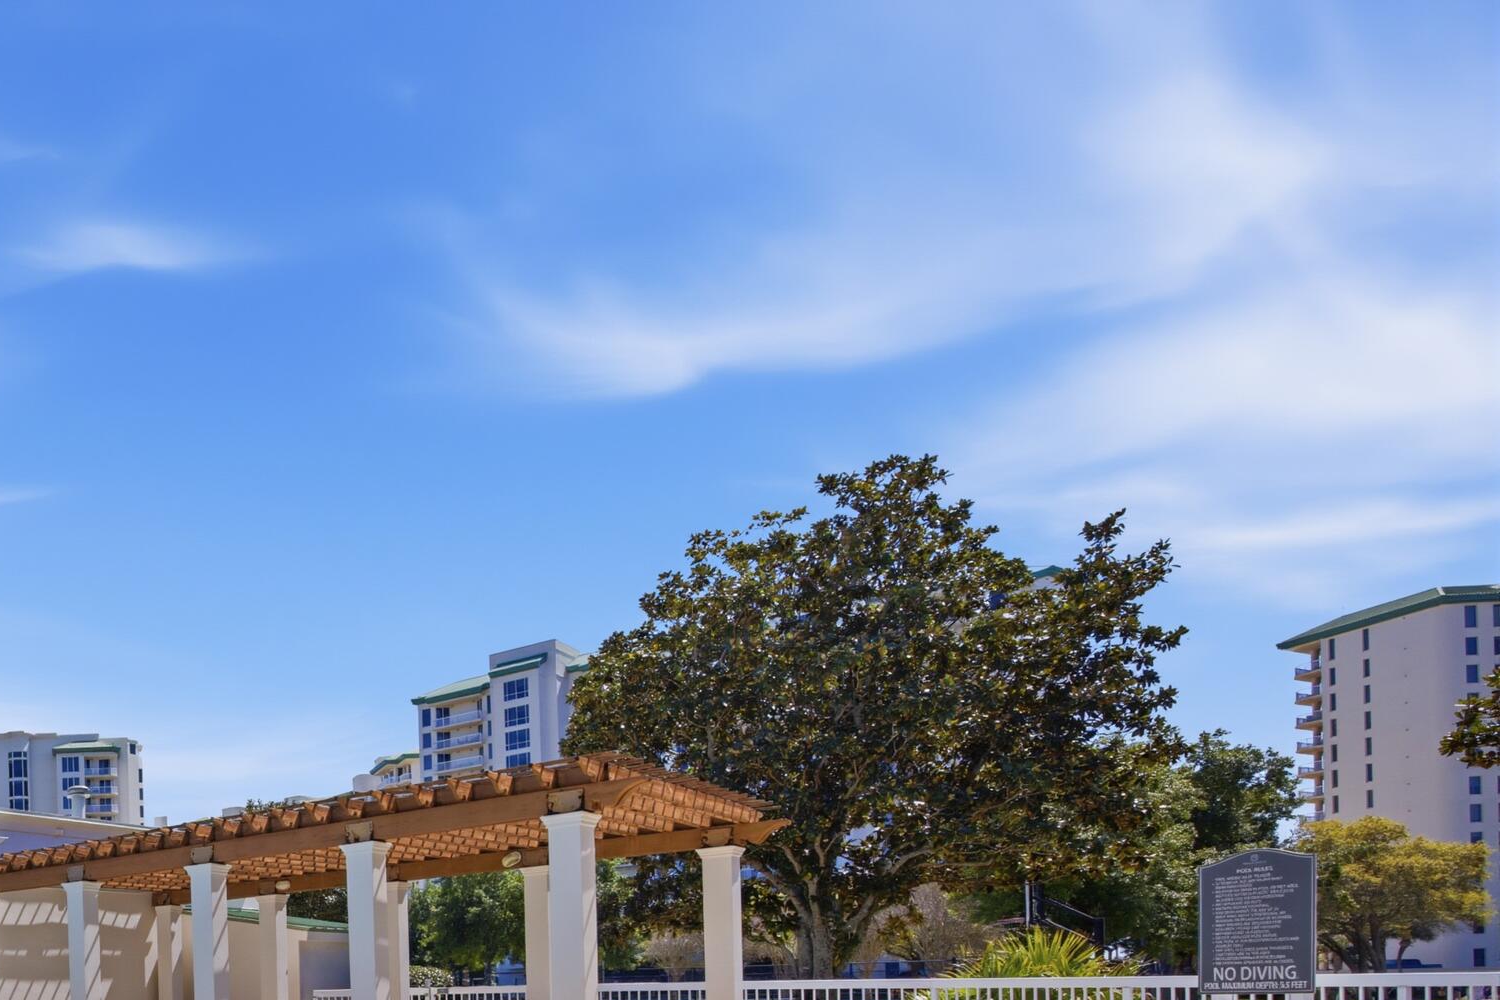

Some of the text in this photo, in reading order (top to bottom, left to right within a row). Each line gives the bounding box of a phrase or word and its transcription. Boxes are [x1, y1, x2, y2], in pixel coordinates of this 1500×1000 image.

[1213, 965, 1297, 981] NO DIVING
[1203, 982, 1220, 990] POOL
[1222, 981, 1254, 989] MAXIMUM
[1291, 980, 1308, 989] FEET
